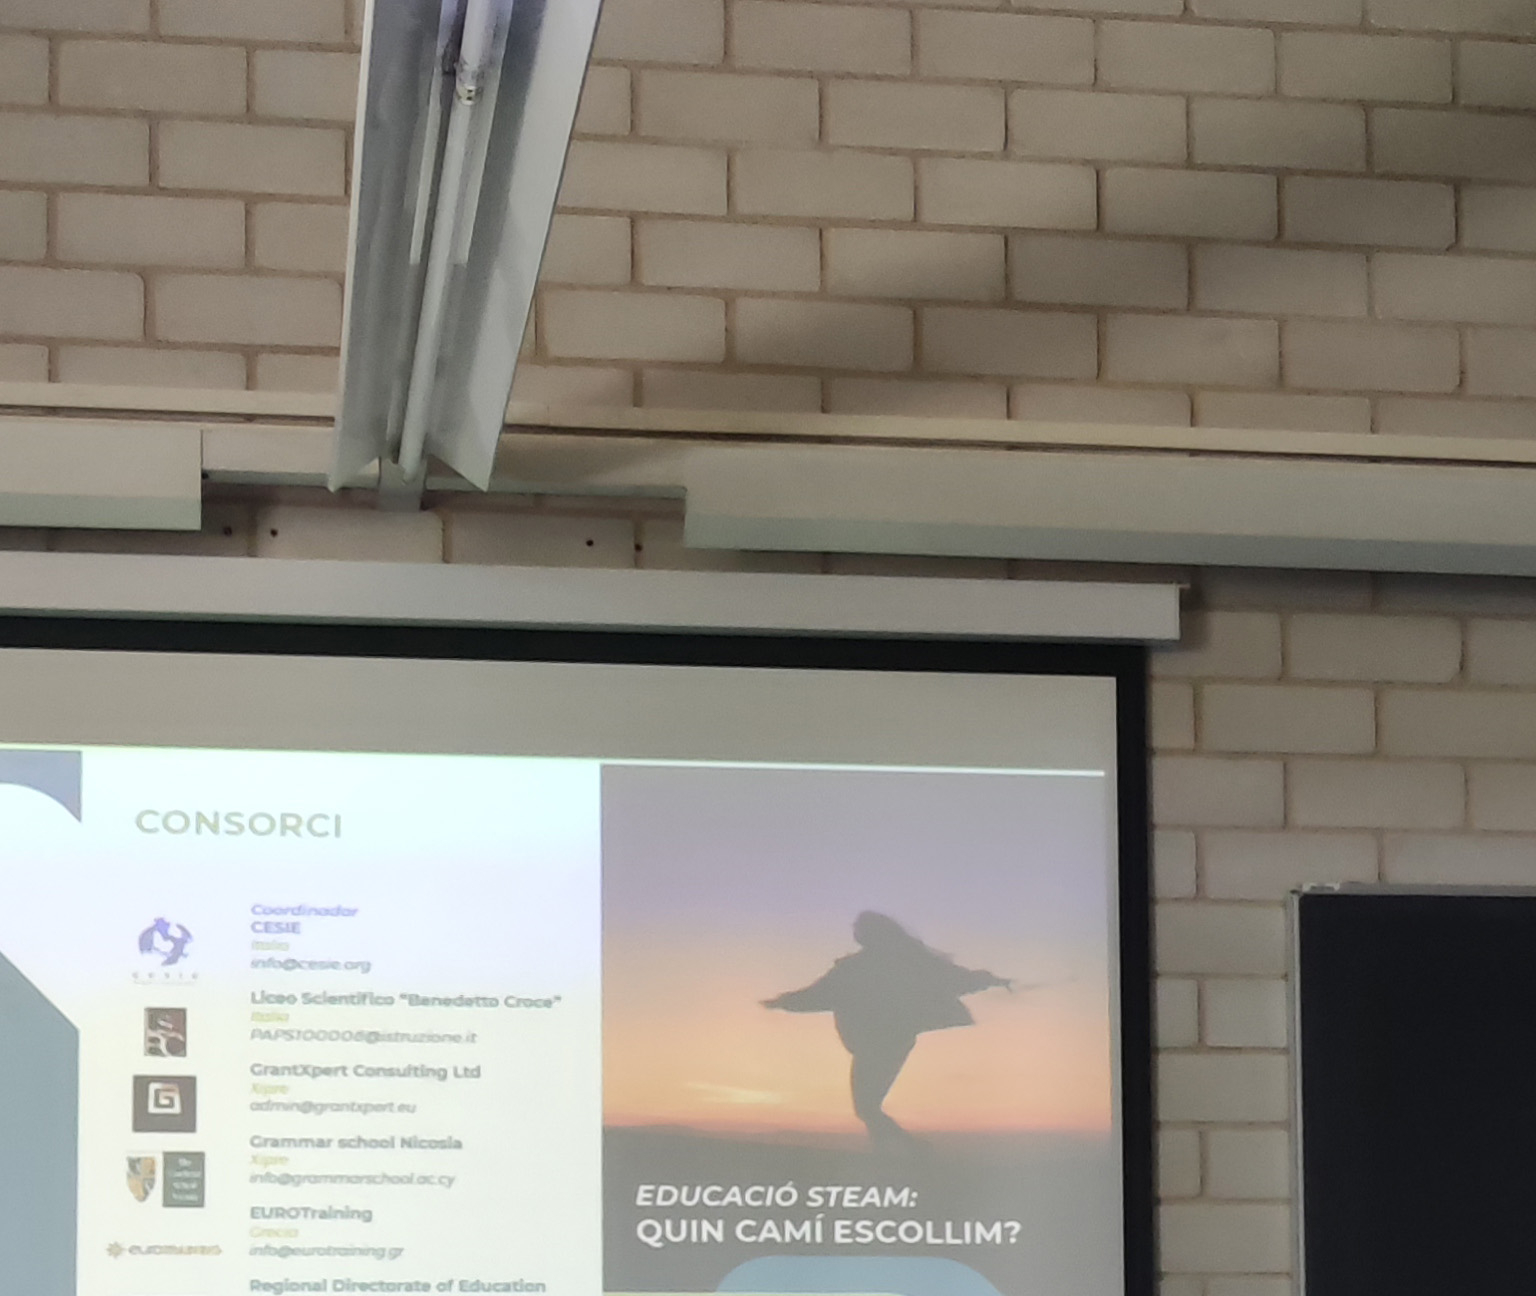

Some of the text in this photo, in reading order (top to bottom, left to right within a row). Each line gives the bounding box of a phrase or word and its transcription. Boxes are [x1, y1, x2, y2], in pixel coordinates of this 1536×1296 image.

[134, 809, 342, 838] CONSORCI
[251, 903, 359, 917] Coordinador
[251, 921, 301, 934] CESIE
[251, 992, 297, 1005] Liceo
[301, 992, 395, 1007] Scientifico
[250, 1064, 481, 1081] GrantXpert Consulting Ltd
[250, 1136, 463, 1151] Grammar school Nicosia
[635, 1181, 918, 1208] EDUCACIÓ STEAM:
[251, 1206, 373, 1222] EUROTraining
[636, 1214, 1021, 1248] QUIN CAMÍ ESCOLLIM?
[249, 1279, 546, 1296] Regional Directorate of Education
